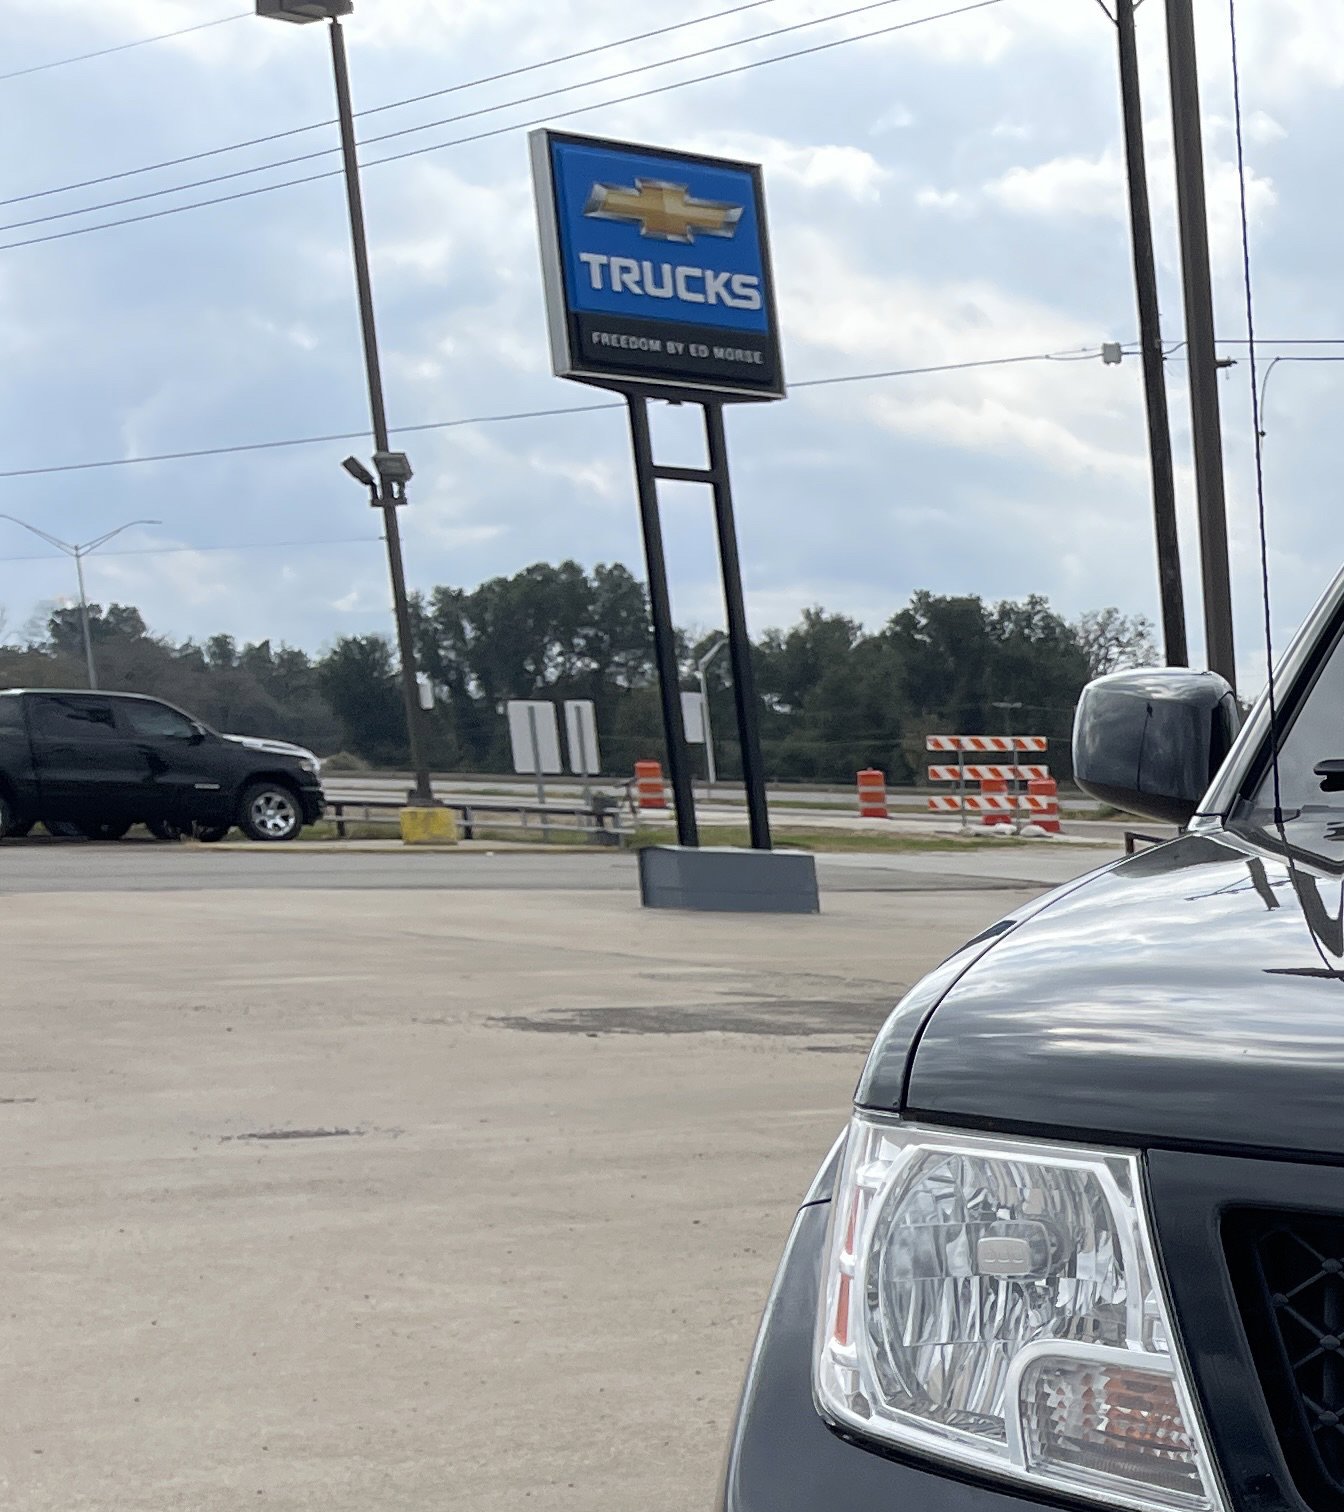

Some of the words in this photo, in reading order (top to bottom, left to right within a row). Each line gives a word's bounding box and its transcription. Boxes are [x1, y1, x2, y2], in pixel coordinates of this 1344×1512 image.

[578, 252, 763, 310] TRUCKS
[592, 331, 661, 352] FREEDOM
[666, 341, 685, 356] BY
[689, 343, 709, 359] ED
[713, 346, 764, 365] MORSE
